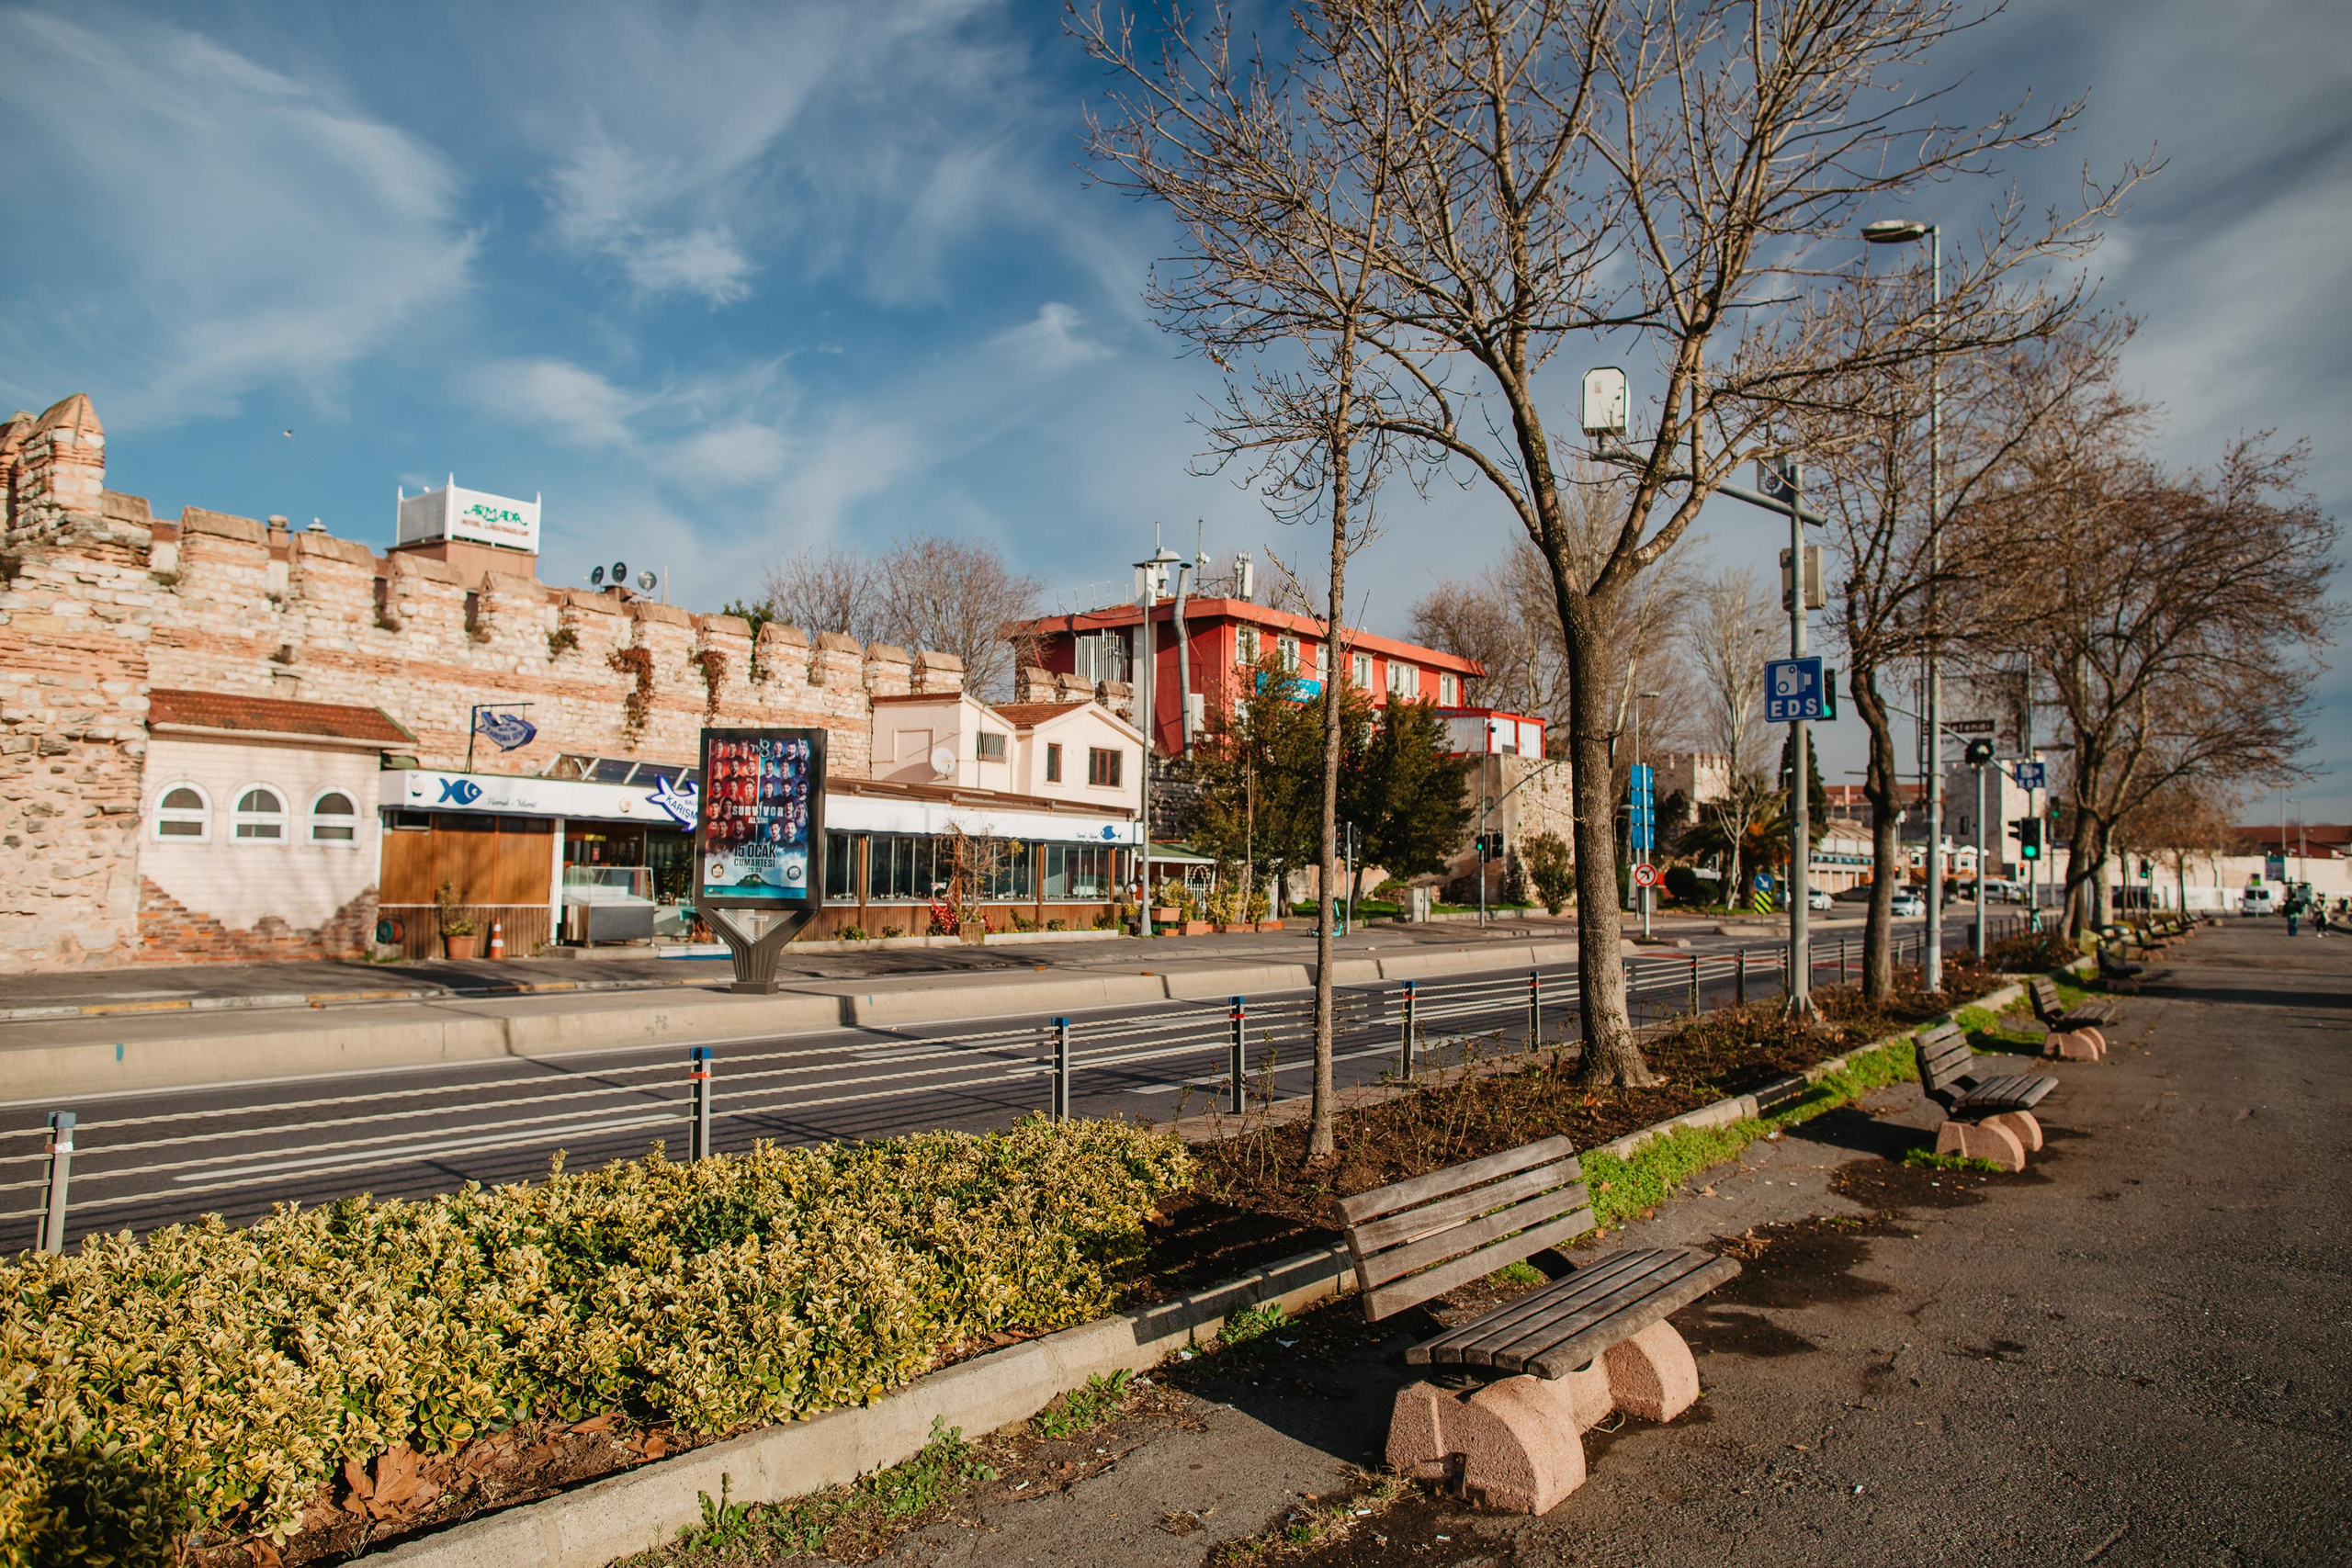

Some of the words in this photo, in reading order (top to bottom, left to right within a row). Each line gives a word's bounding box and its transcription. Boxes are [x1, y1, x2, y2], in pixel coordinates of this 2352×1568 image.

[464, 504, 527, 525] ARMADA
[1770, 697, 1818, 717] EDS
[2018, 777, 2043, 789] EDS
[747, 816, 757, 824] ALL
[734, 844, 745, 858] 15
[747, 844, 776, 859] OCAK
[733, 857, 776, 868] CUMARTESİ
